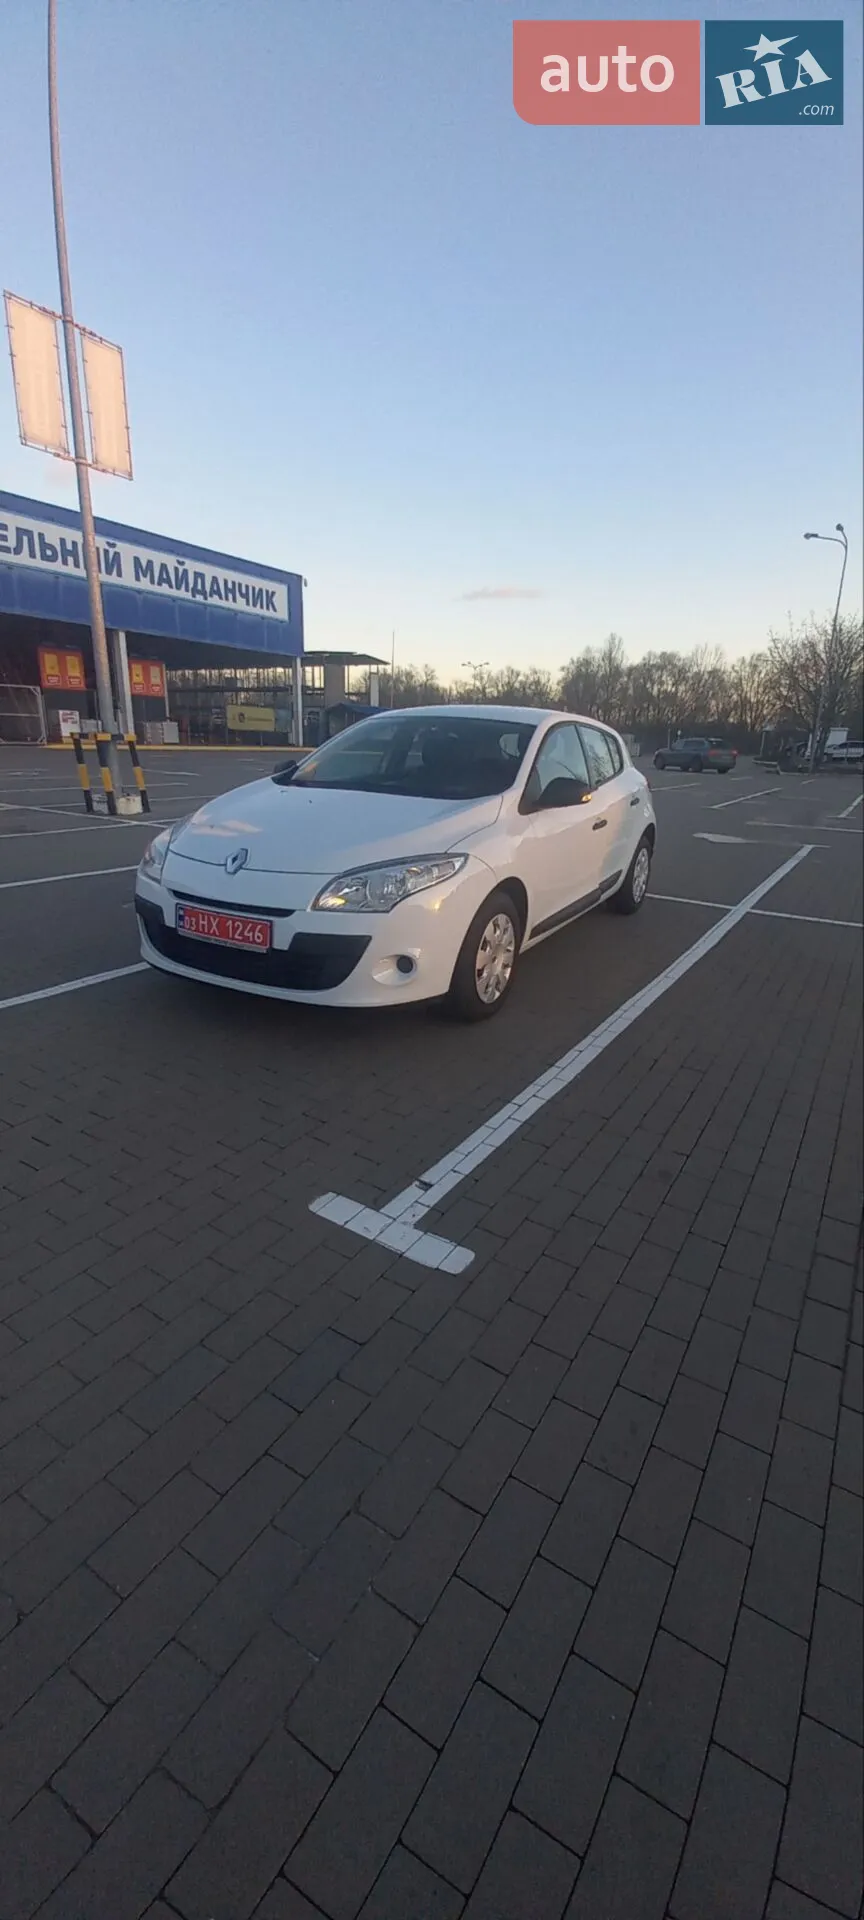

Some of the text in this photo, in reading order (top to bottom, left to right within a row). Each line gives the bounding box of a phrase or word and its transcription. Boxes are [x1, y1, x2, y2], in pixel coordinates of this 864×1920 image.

[132, 555, 278, 613] МАЙДАНЧИК
[184, 915, 197, 931] 03
[226, 919, 264, 943] 1246
